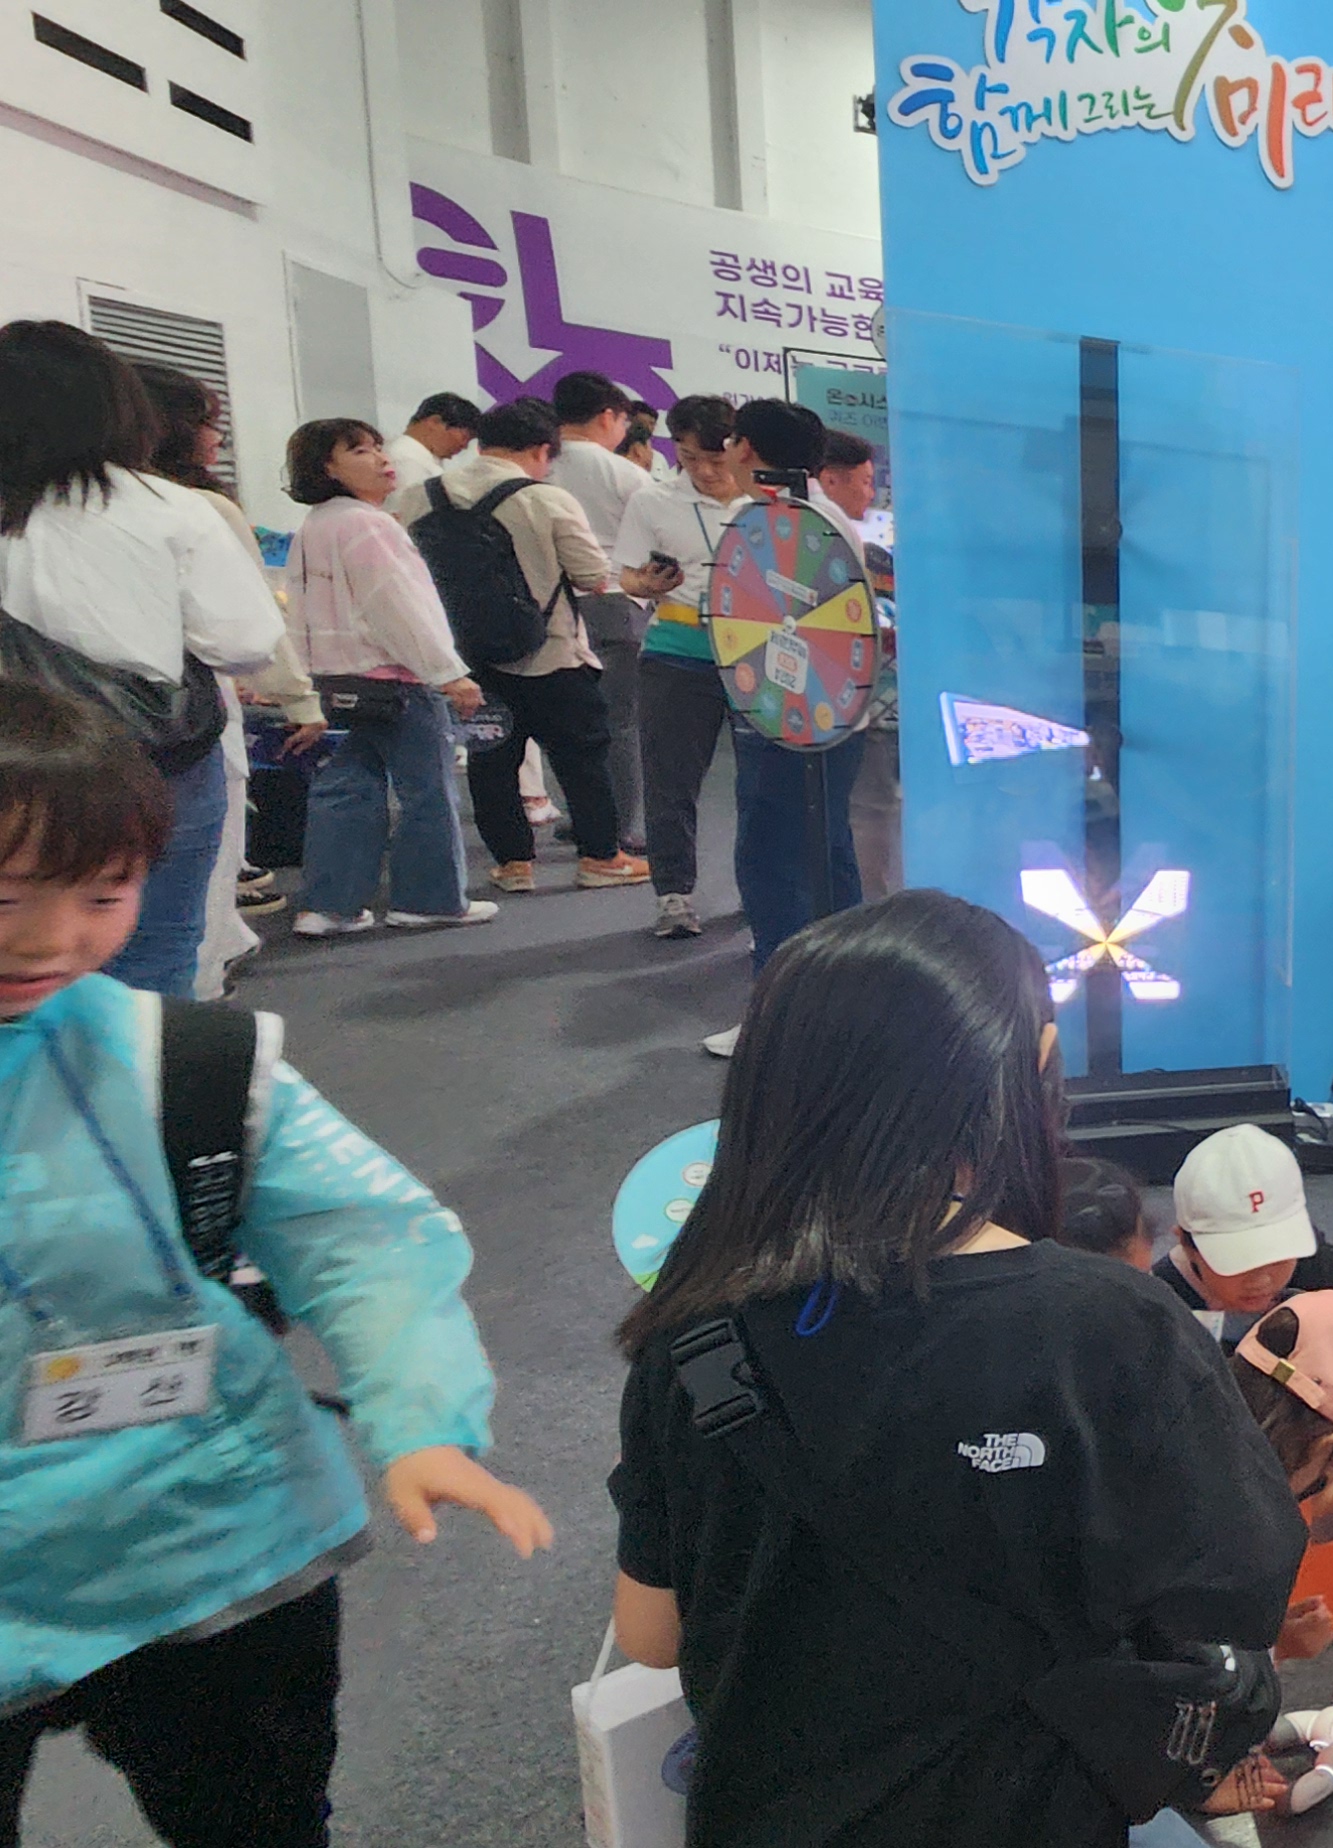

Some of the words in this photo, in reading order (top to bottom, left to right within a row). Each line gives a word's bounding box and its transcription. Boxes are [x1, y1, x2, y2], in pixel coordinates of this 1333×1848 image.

[899, 62, 1068, 175] 함께
[1078, 86, 1176, 124] 그리는
[709, 249, 812, 294] 공생의
[1248, 1190, 1265, 1214] P
[957, 1441, 1016, 1461] NORTH
[983, 1433, 1018, 1447] THE
[971, 1457, 1014, 1473] FACE
